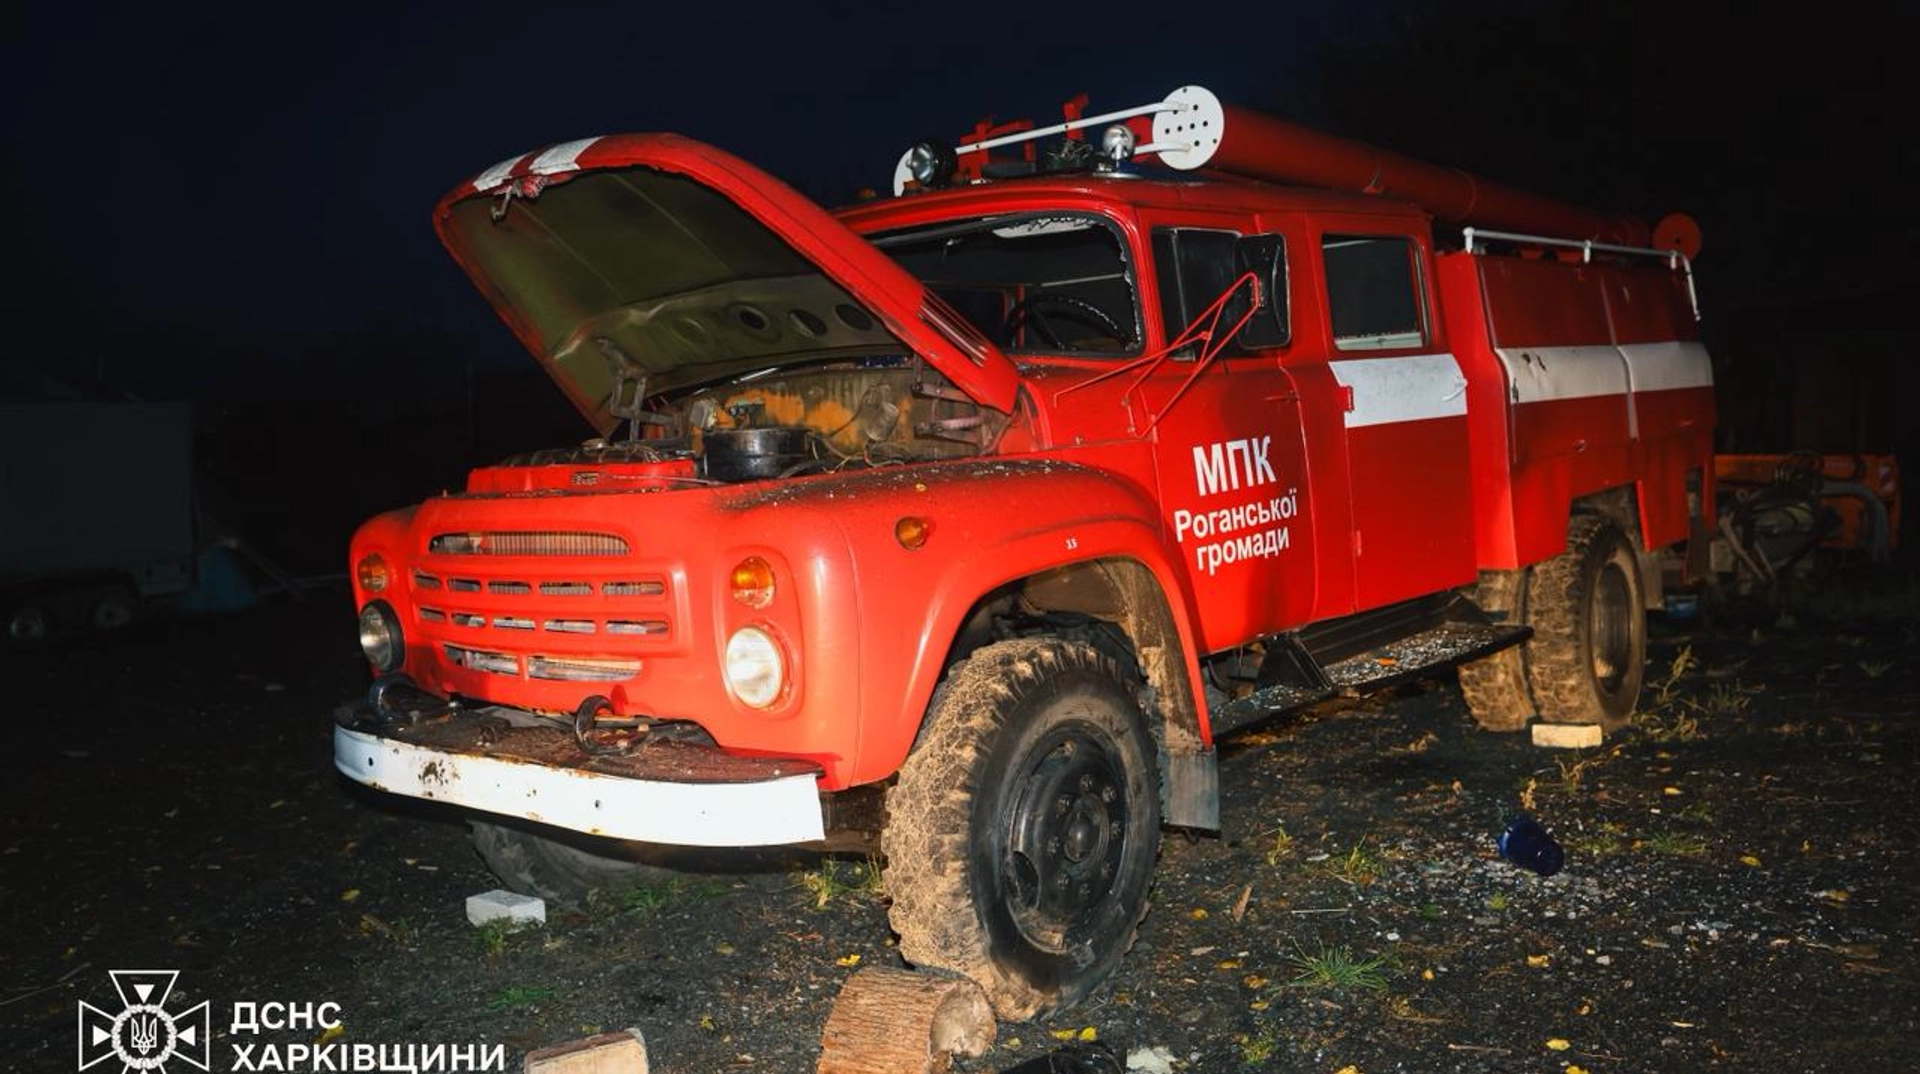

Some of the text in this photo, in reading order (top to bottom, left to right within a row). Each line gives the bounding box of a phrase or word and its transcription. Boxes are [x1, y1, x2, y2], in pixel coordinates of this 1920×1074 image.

[1193, 435, 1276, 496] МПК
[1174, 488, 1297, 542] Роганської
[1196, 526, 1289, 576] громади
